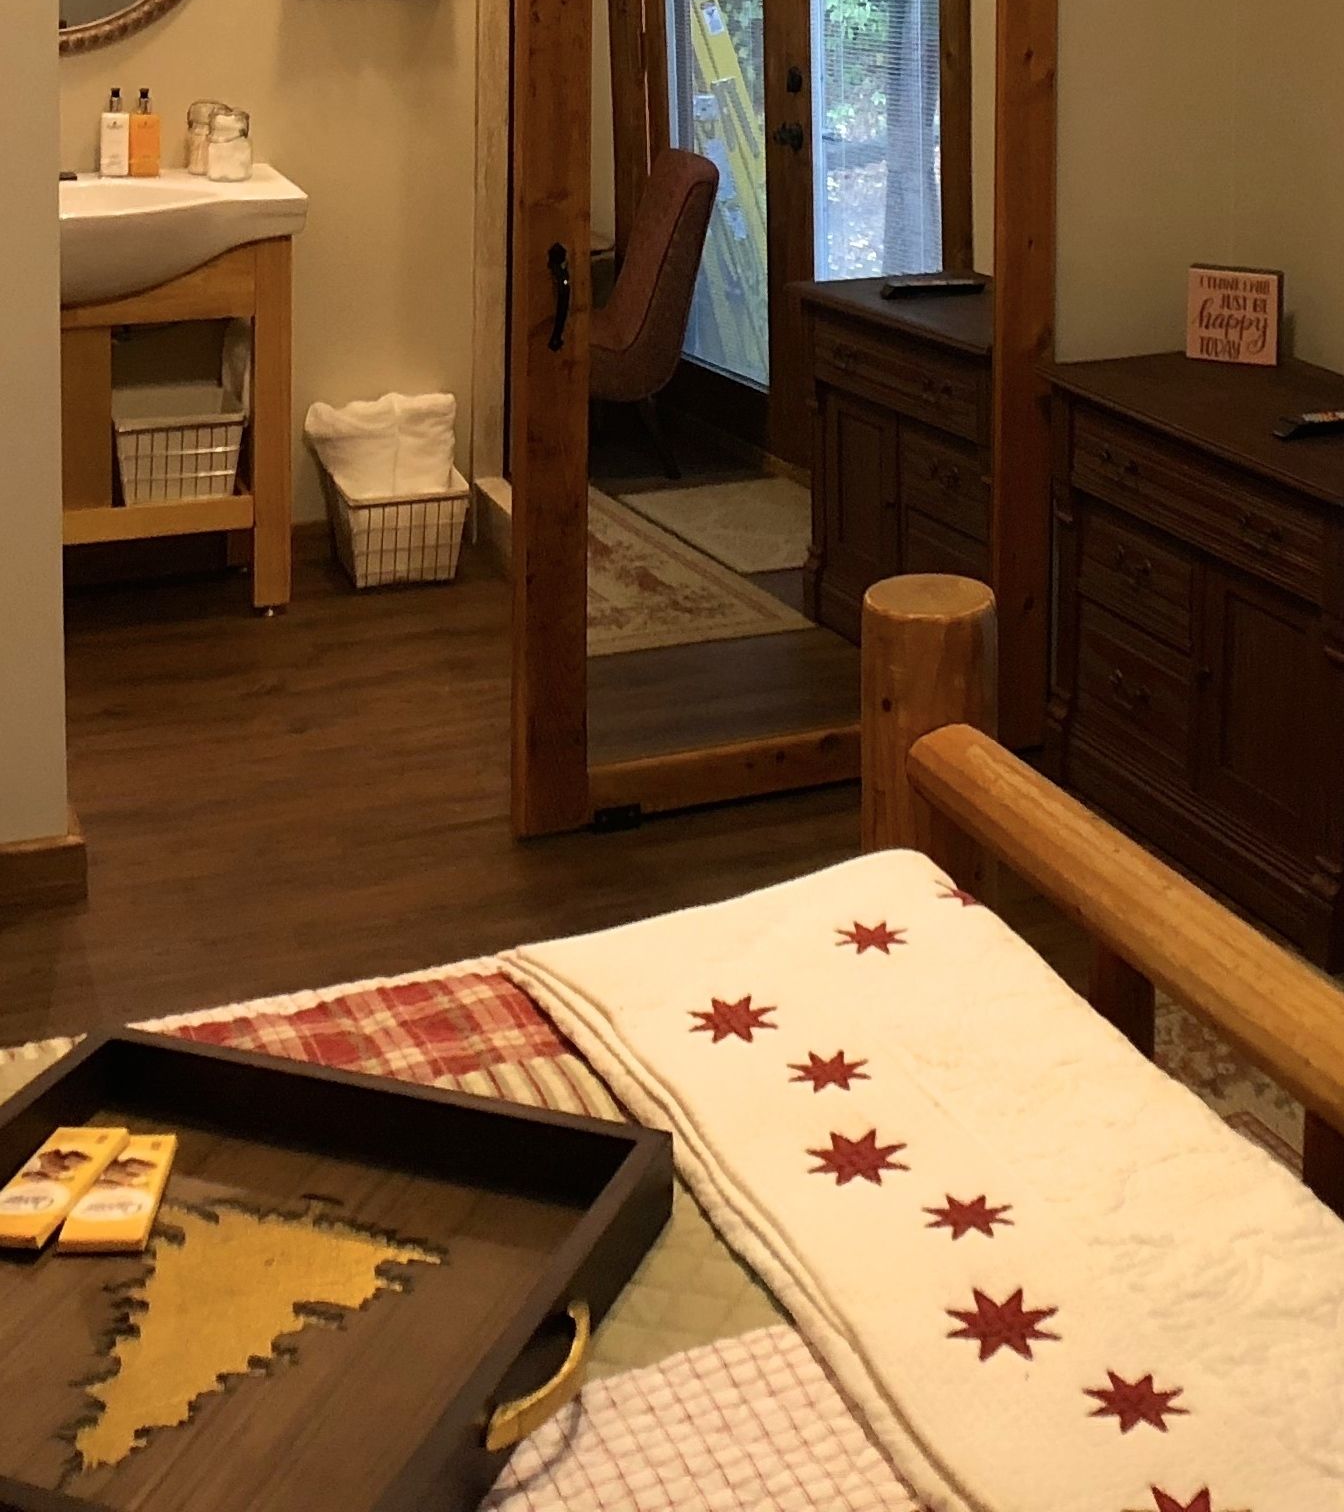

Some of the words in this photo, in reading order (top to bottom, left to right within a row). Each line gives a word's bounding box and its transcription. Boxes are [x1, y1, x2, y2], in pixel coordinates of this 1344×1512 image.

[1219, 294, 1247, 311] JUST
[1253, 297, 1267, 314] BE
[1198, 297, 1268, 355] happy
[1199, 336, 1241, 360] TODAY
